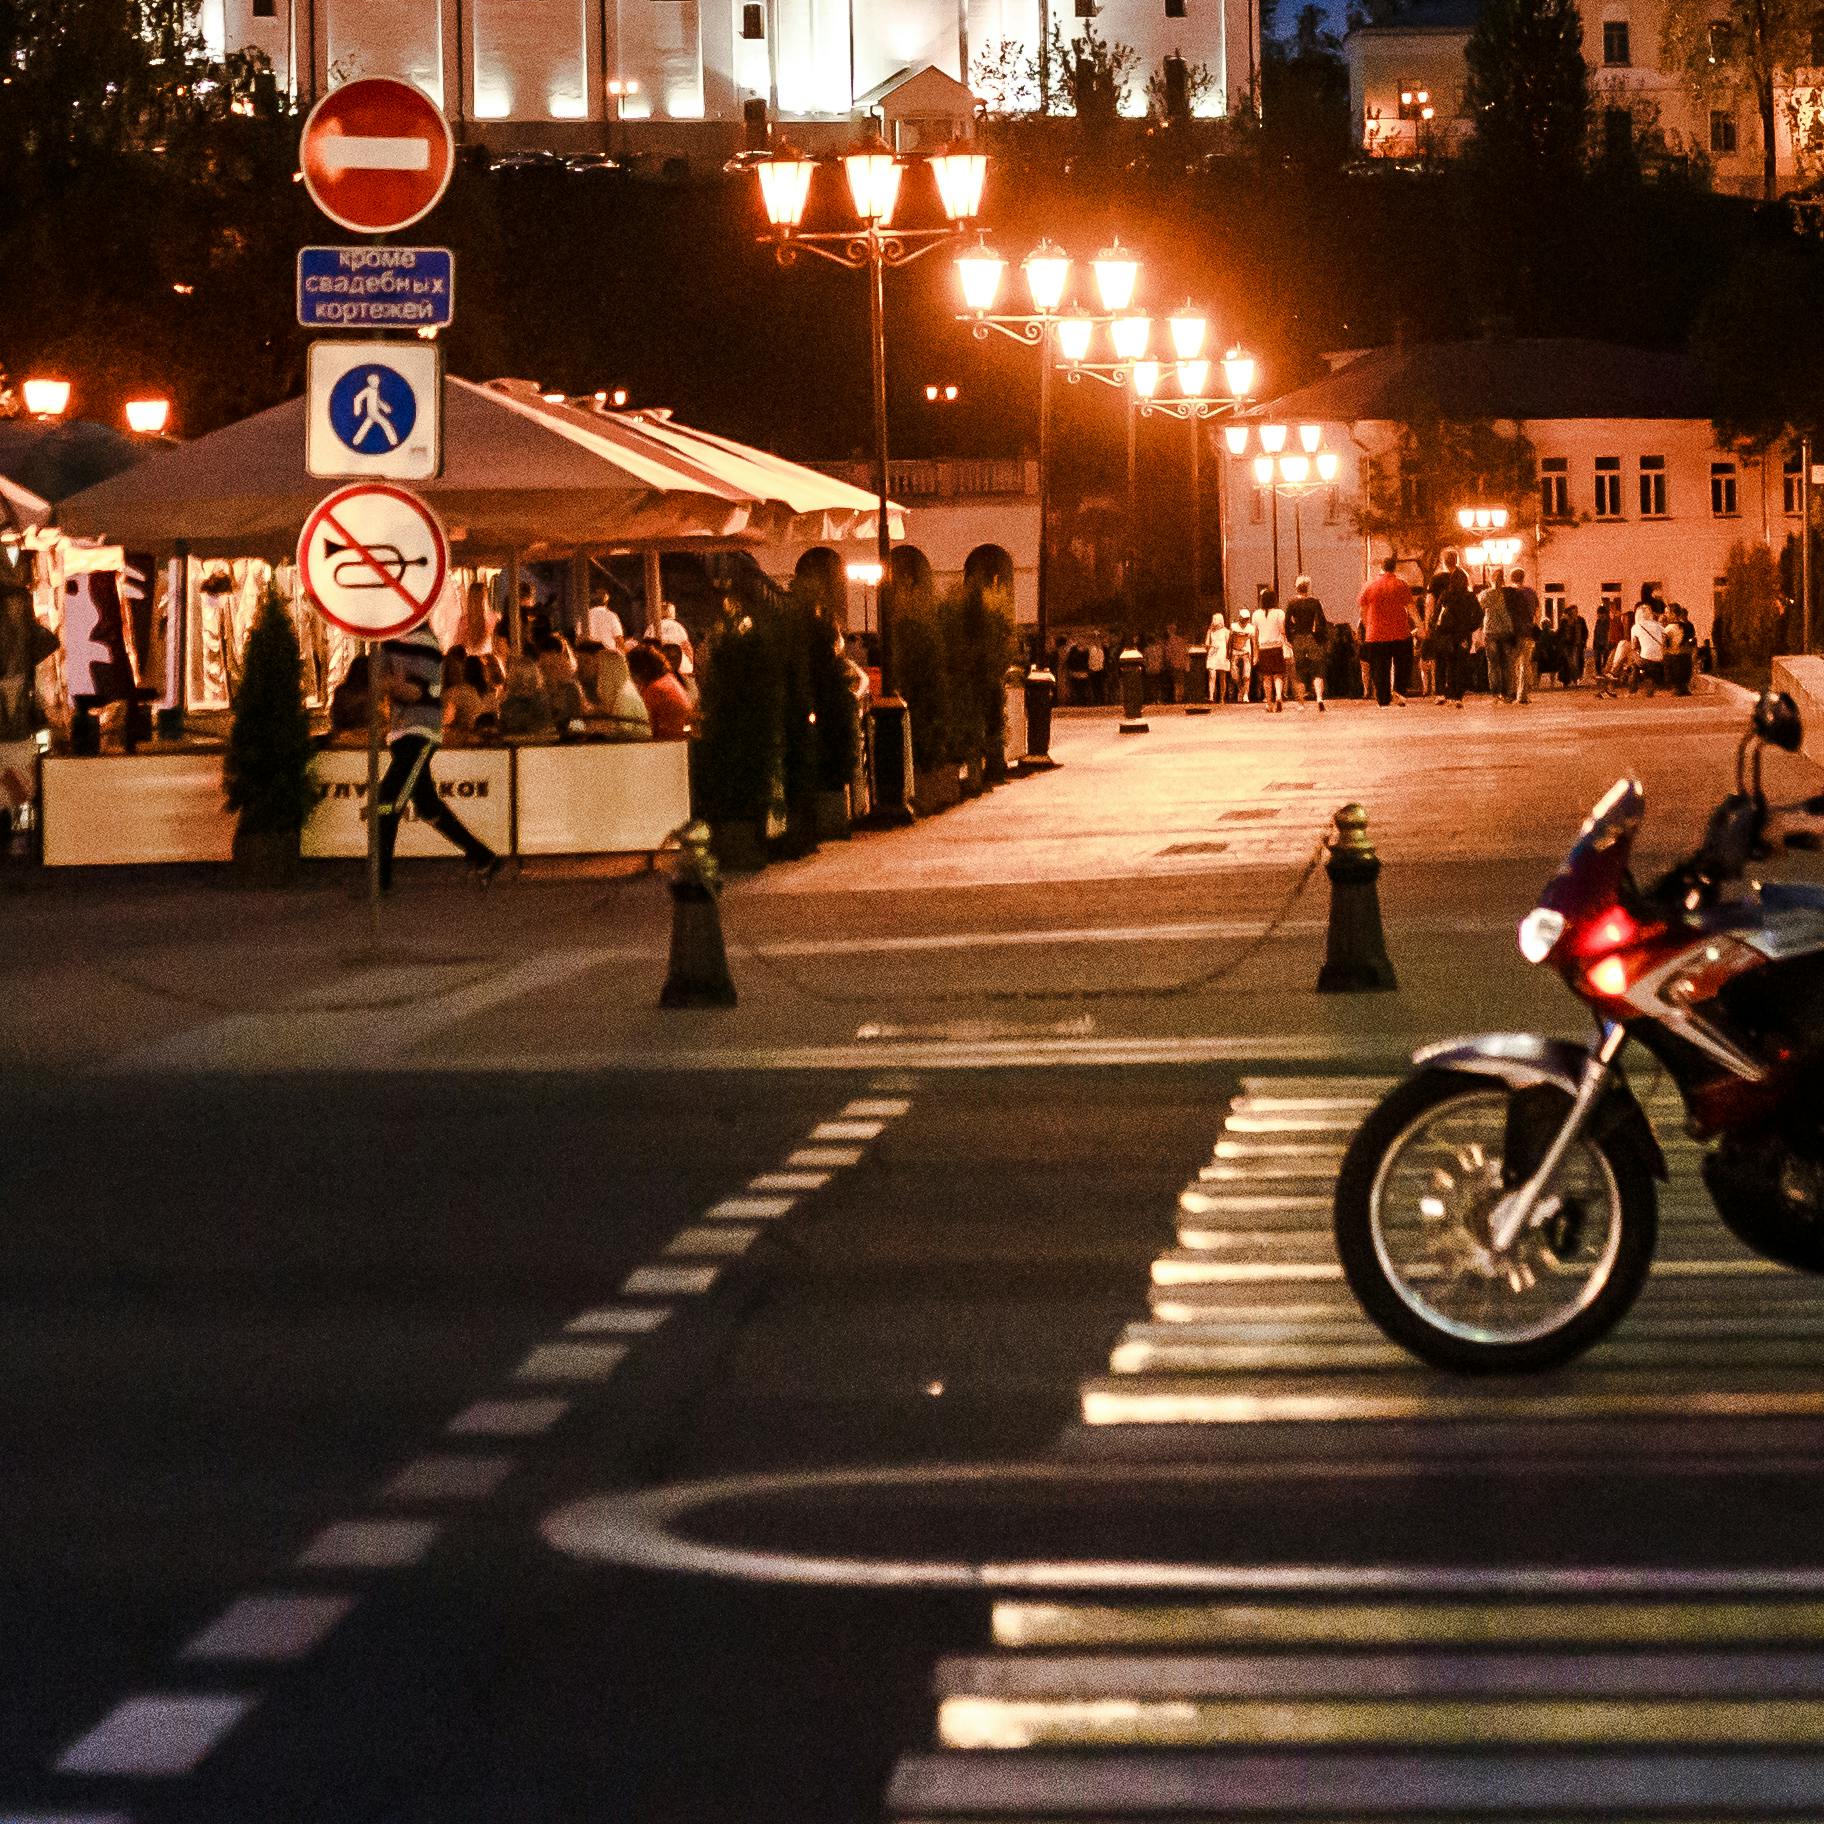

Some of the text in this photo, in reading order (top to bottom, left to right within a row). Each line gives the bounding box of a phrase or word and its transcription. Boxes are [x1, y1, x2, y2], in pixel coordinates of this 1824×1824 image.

[339, 250, 416, 271] кроме
[305, 270, 445, 294] свадебных
[315, 299, 434, 323] кортежей
